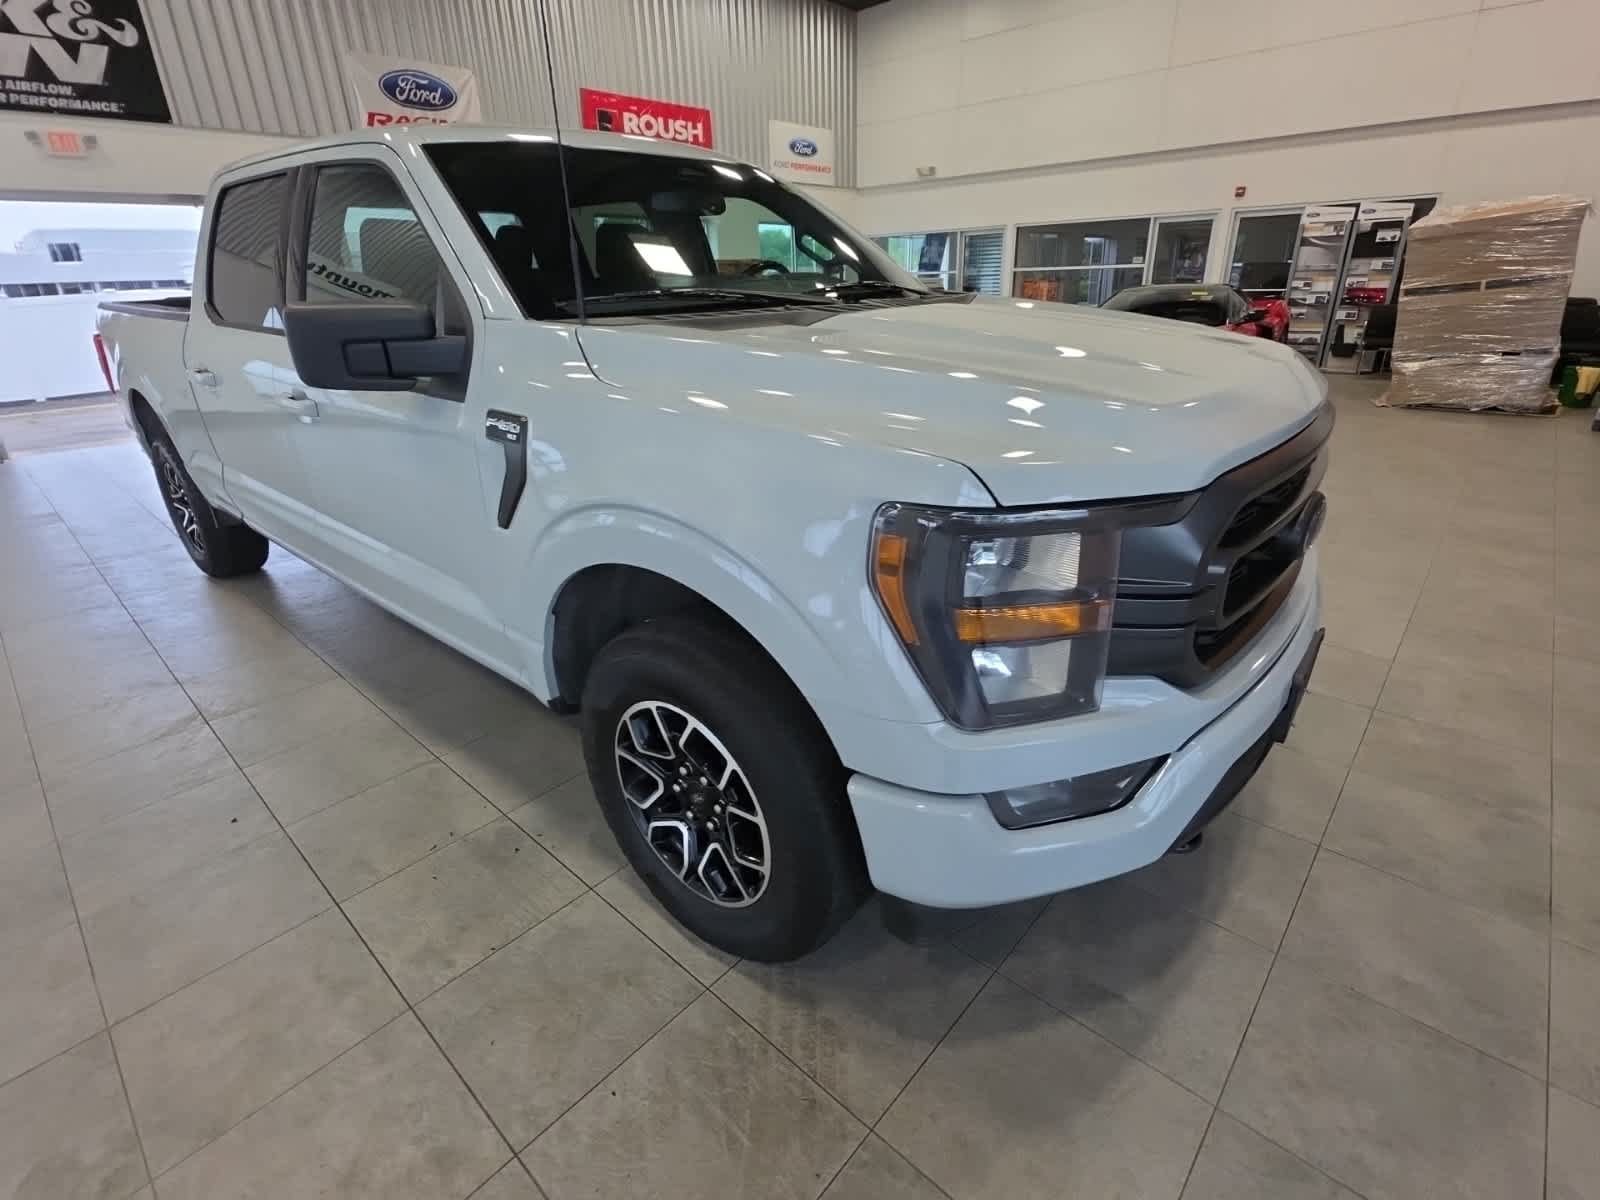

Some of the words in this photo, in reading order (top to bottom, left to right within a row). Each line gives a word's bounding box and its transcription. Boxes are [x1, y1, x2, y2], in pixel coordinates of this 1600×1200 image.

[5, 80, 76, 97] AIRFLOW.
[395, 75, 444, 105] Ford
[622, 111, 704, 143] ROUSH
